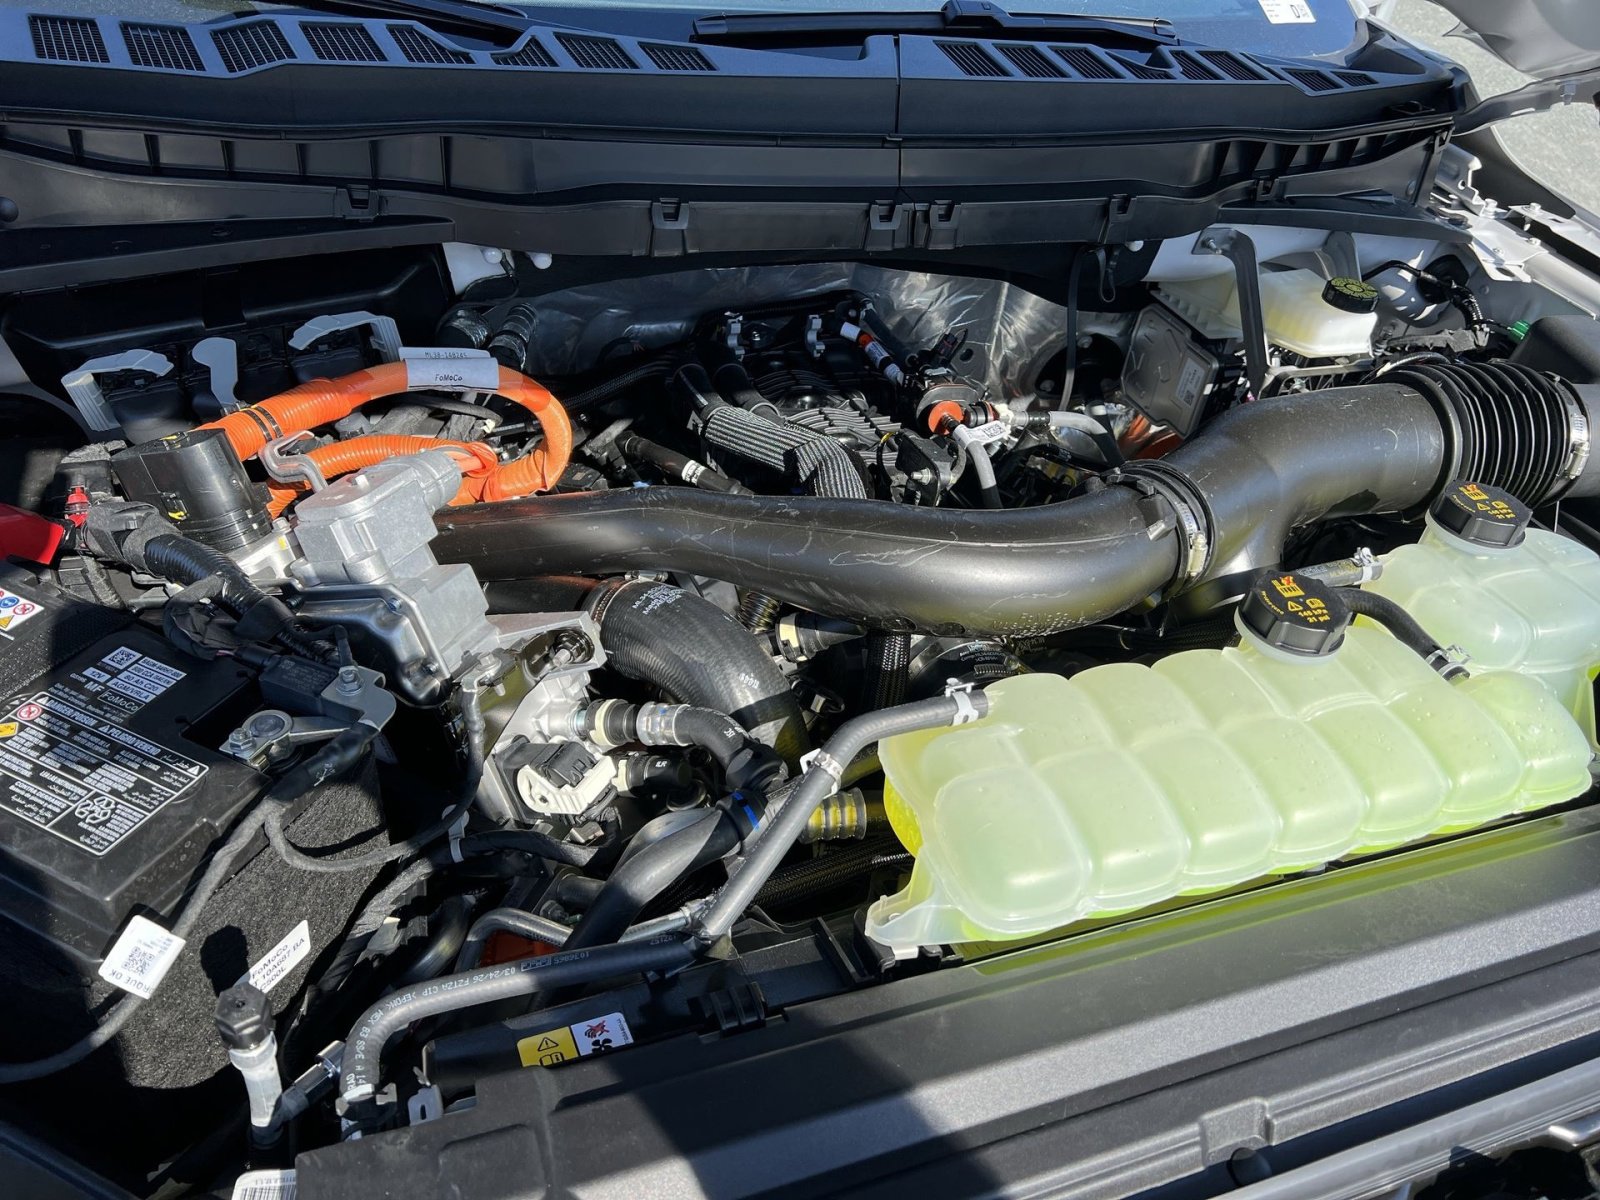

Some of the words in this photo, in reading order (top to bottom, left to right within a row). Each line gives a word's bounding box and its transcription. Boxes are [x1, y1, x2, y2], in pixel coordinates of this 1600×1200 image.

[434, 374, 463, 382] FoMoCo
[89, 669, 105, 680] 12V
[84, 681, 106, 693] MF
[112, 680, 151, 701] AGM/VRLA
[100, 691, 140, 712] FoMoCo
[252, 944, 288, 980] FoMoCo
[109, 968, 123, 981] OK
[473, 967, 516, 984] 03/24/26
[368, 1009, 384, 1025] MEX
